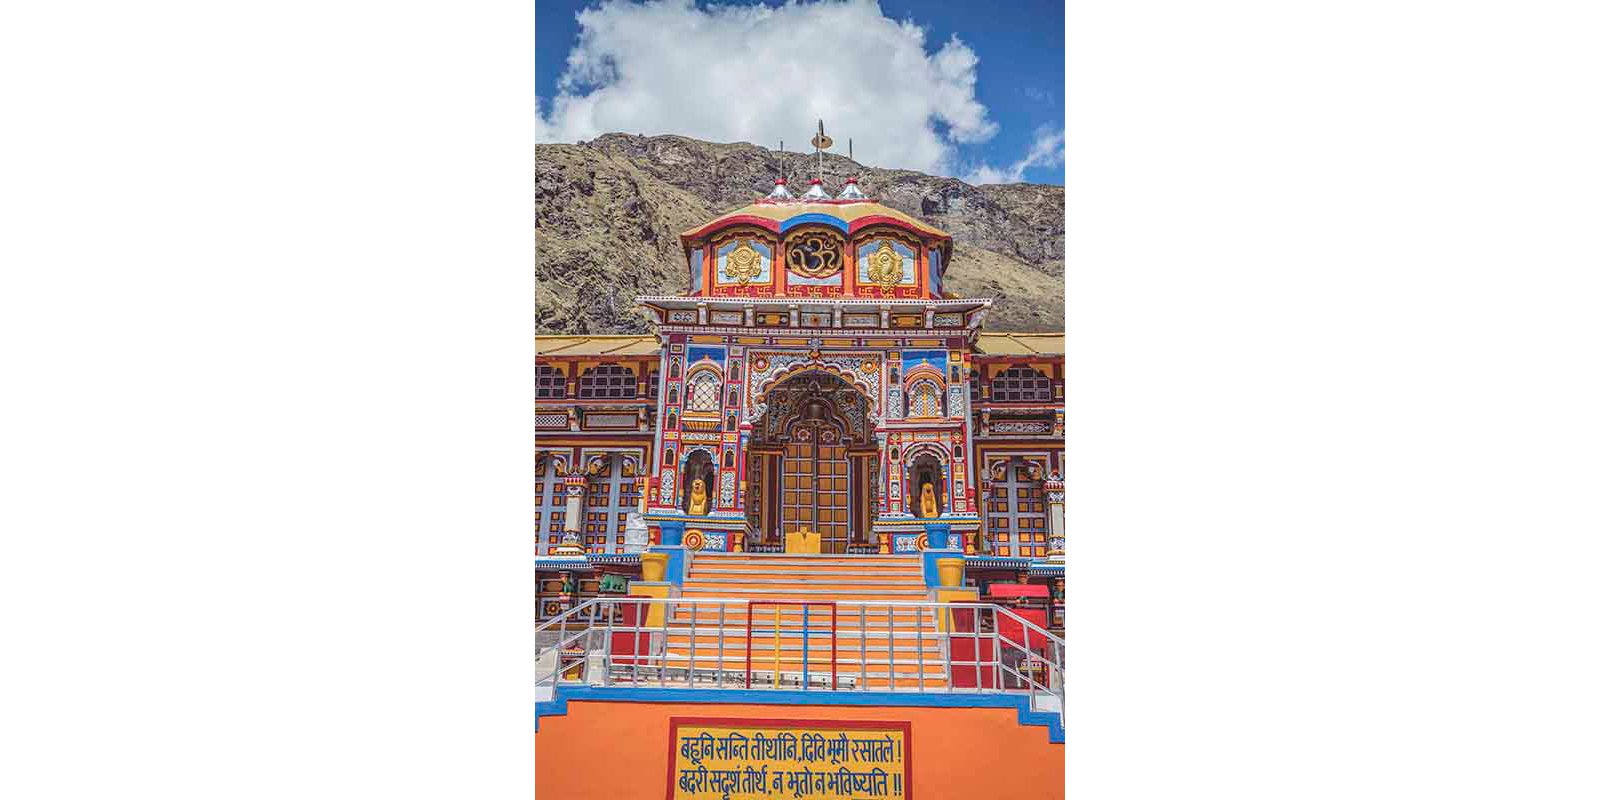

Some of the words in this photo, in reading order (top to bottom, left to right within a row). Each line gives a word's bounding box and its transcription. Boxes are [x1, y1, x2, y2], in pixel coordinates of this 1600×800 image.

[681, 732, 715, 766] बहूनि
[716, 732, 749, 760] सन्ति
[827, 731, 849, 764] भूमौ
[851, 734, 894, 762] रसातले
[679, 765, 708, 795] बदरी
[772, 771, 784, 794] न
[786, 766, 813, 798] भूतो
[815, 771, 825, 794] न
[828, 766, 888, 796] भविष्यति
